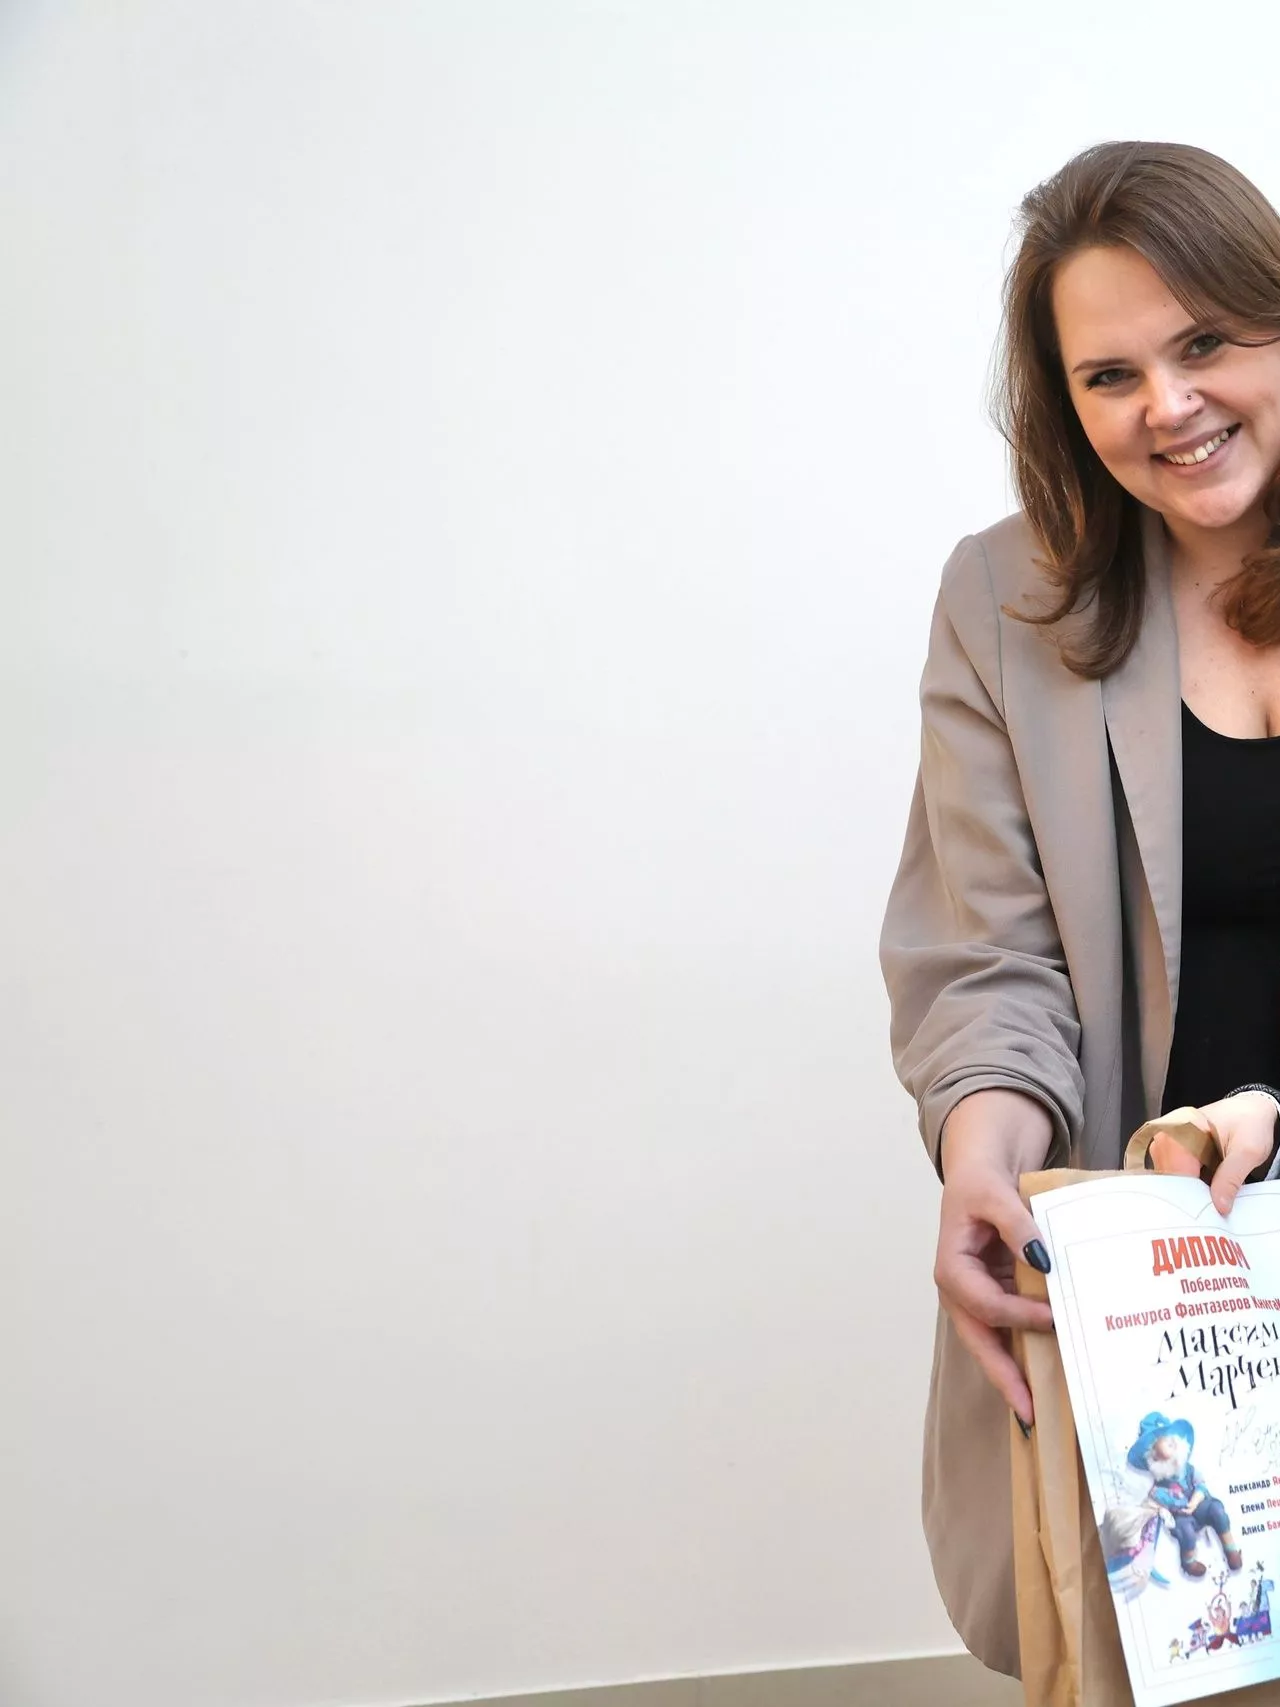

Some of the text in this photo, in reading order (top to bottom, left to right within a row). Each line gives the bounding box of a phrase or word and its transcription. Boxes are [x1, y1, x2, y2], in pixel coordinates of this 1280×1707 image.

[1151, 1235, 1251, 1276] ДИПЛОМ
[1180, 1275, 1250, 1294] Победителя
[1105, 1307, 1171, 1331] Конкурса
[1174, 1297, 1251, 1319] Фантазеров
[1229, 1479, 1271, 1495] Александр
[1241, 1502, 1265, 1514] Елена
[1241, 1523, 1265, 1536] Алиса
